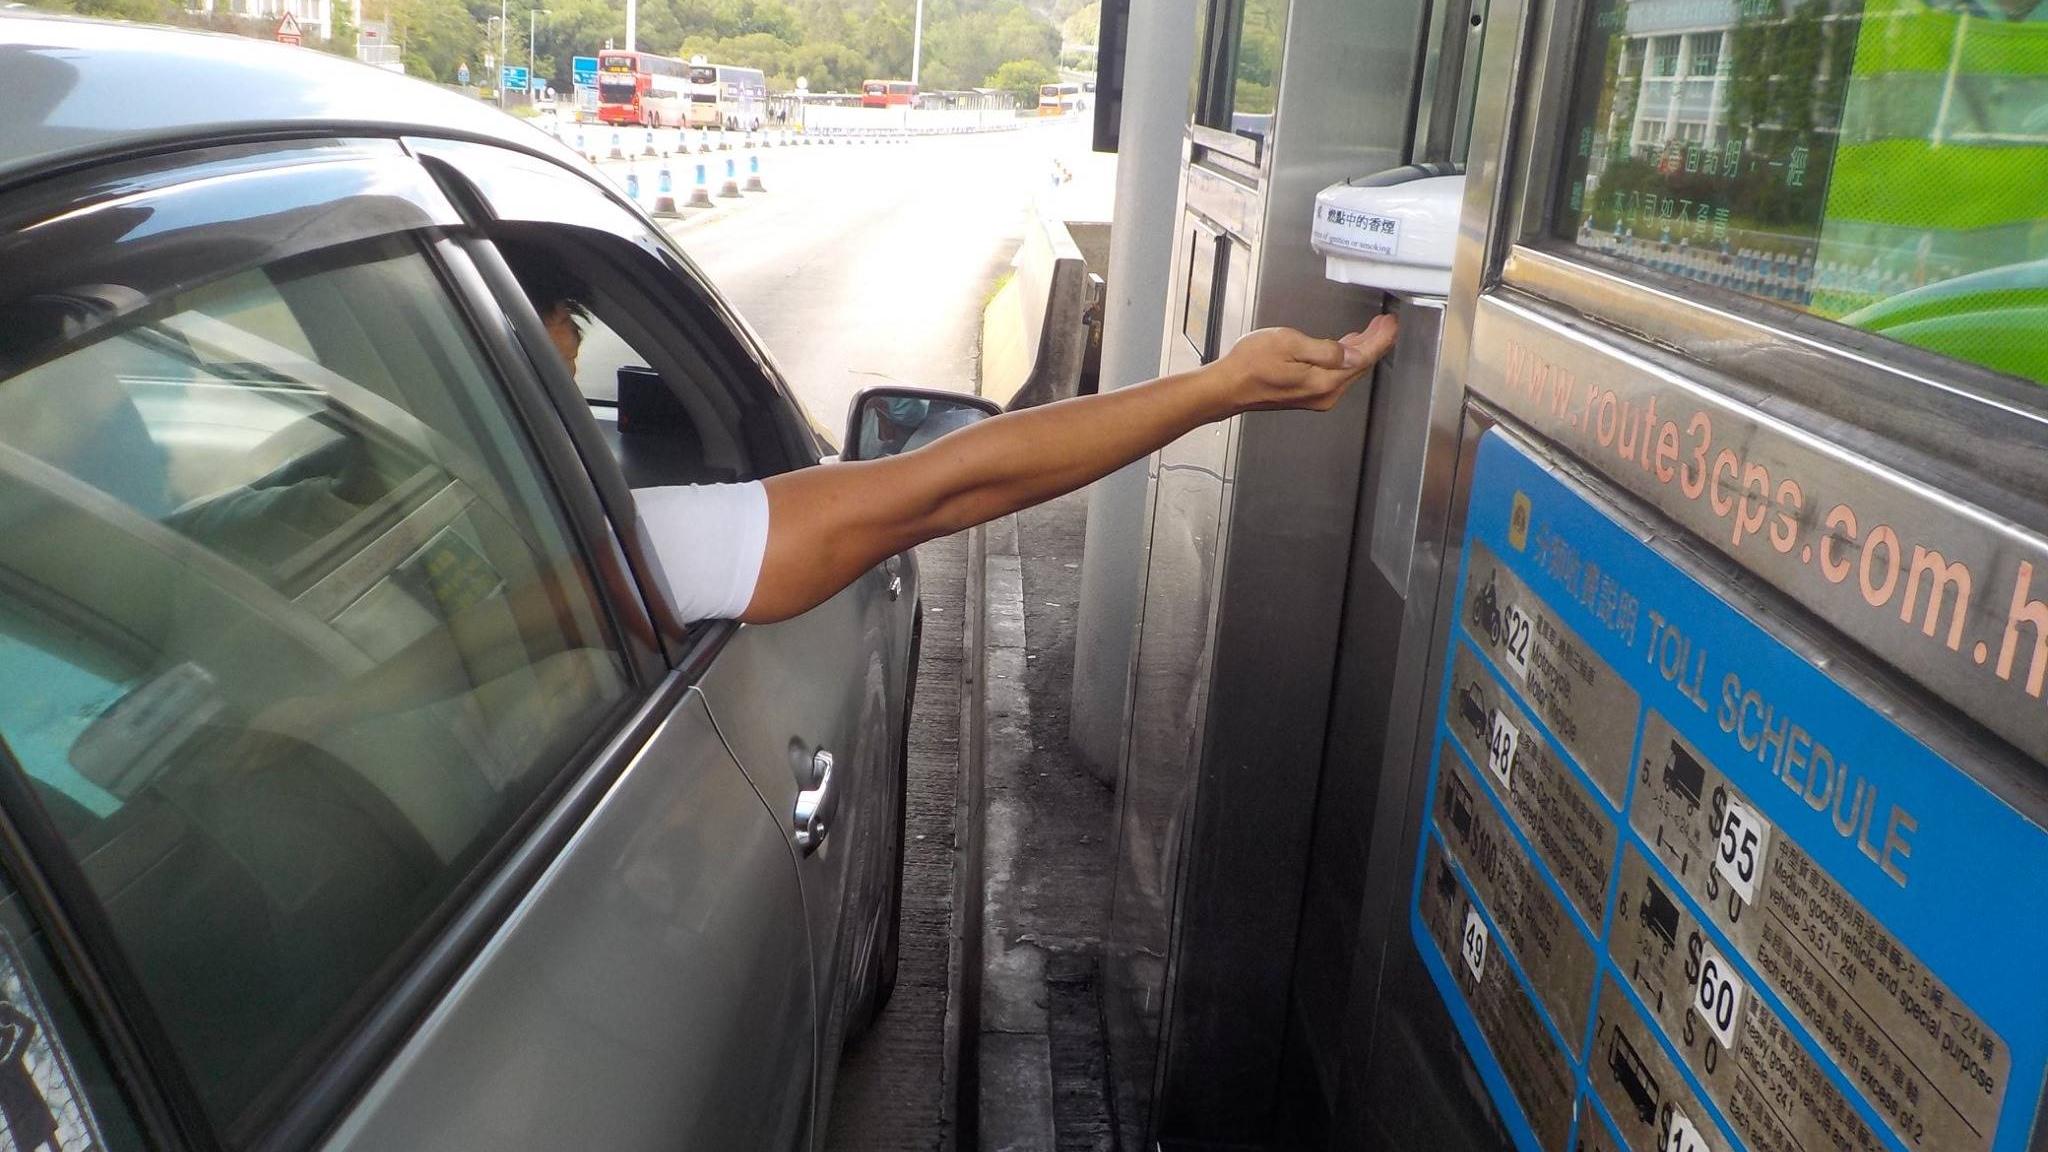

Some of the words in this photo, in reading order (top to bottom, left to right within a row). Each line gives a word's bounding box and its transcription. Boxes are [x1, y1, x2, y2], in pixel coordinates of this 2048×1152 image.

[1527, 668, 1547, 709] Motor
[1648, 609, 1709, 713] TOLL
[1717, 672, 1918, 889] SCHEDULE
[1709, 783, 1758, 883] $55
[1769, 885, 1801, 927] vehicle
[1684, 929, 1734, 1032] $60
[1774, 858, 1809, 905] Medium
[1808, 898, 1839, 937] goods
[1840, 927, 1876, 974] vehicle
[1876, 966, 1899, 997] and
[1899, 988, 1943, 1041] special
[1940, 1031, 1994, 1096] purpose
[1740, 1040, 1768, 1084] vehicle
[1744, 1016, 1770, 1059] Heavy
[1768, 1050, 1798, 1092] goods
[1757, 943, 1780, 981] Each
[1780, 973, 1825, 1033] additional
[1825, 1026, 1848, 1059] axle
[1861, 1065, 1898, 1117] excess
[1913, 1123, 1924, 1146] 2
[1729, 1095, 1751, 1135] Each
